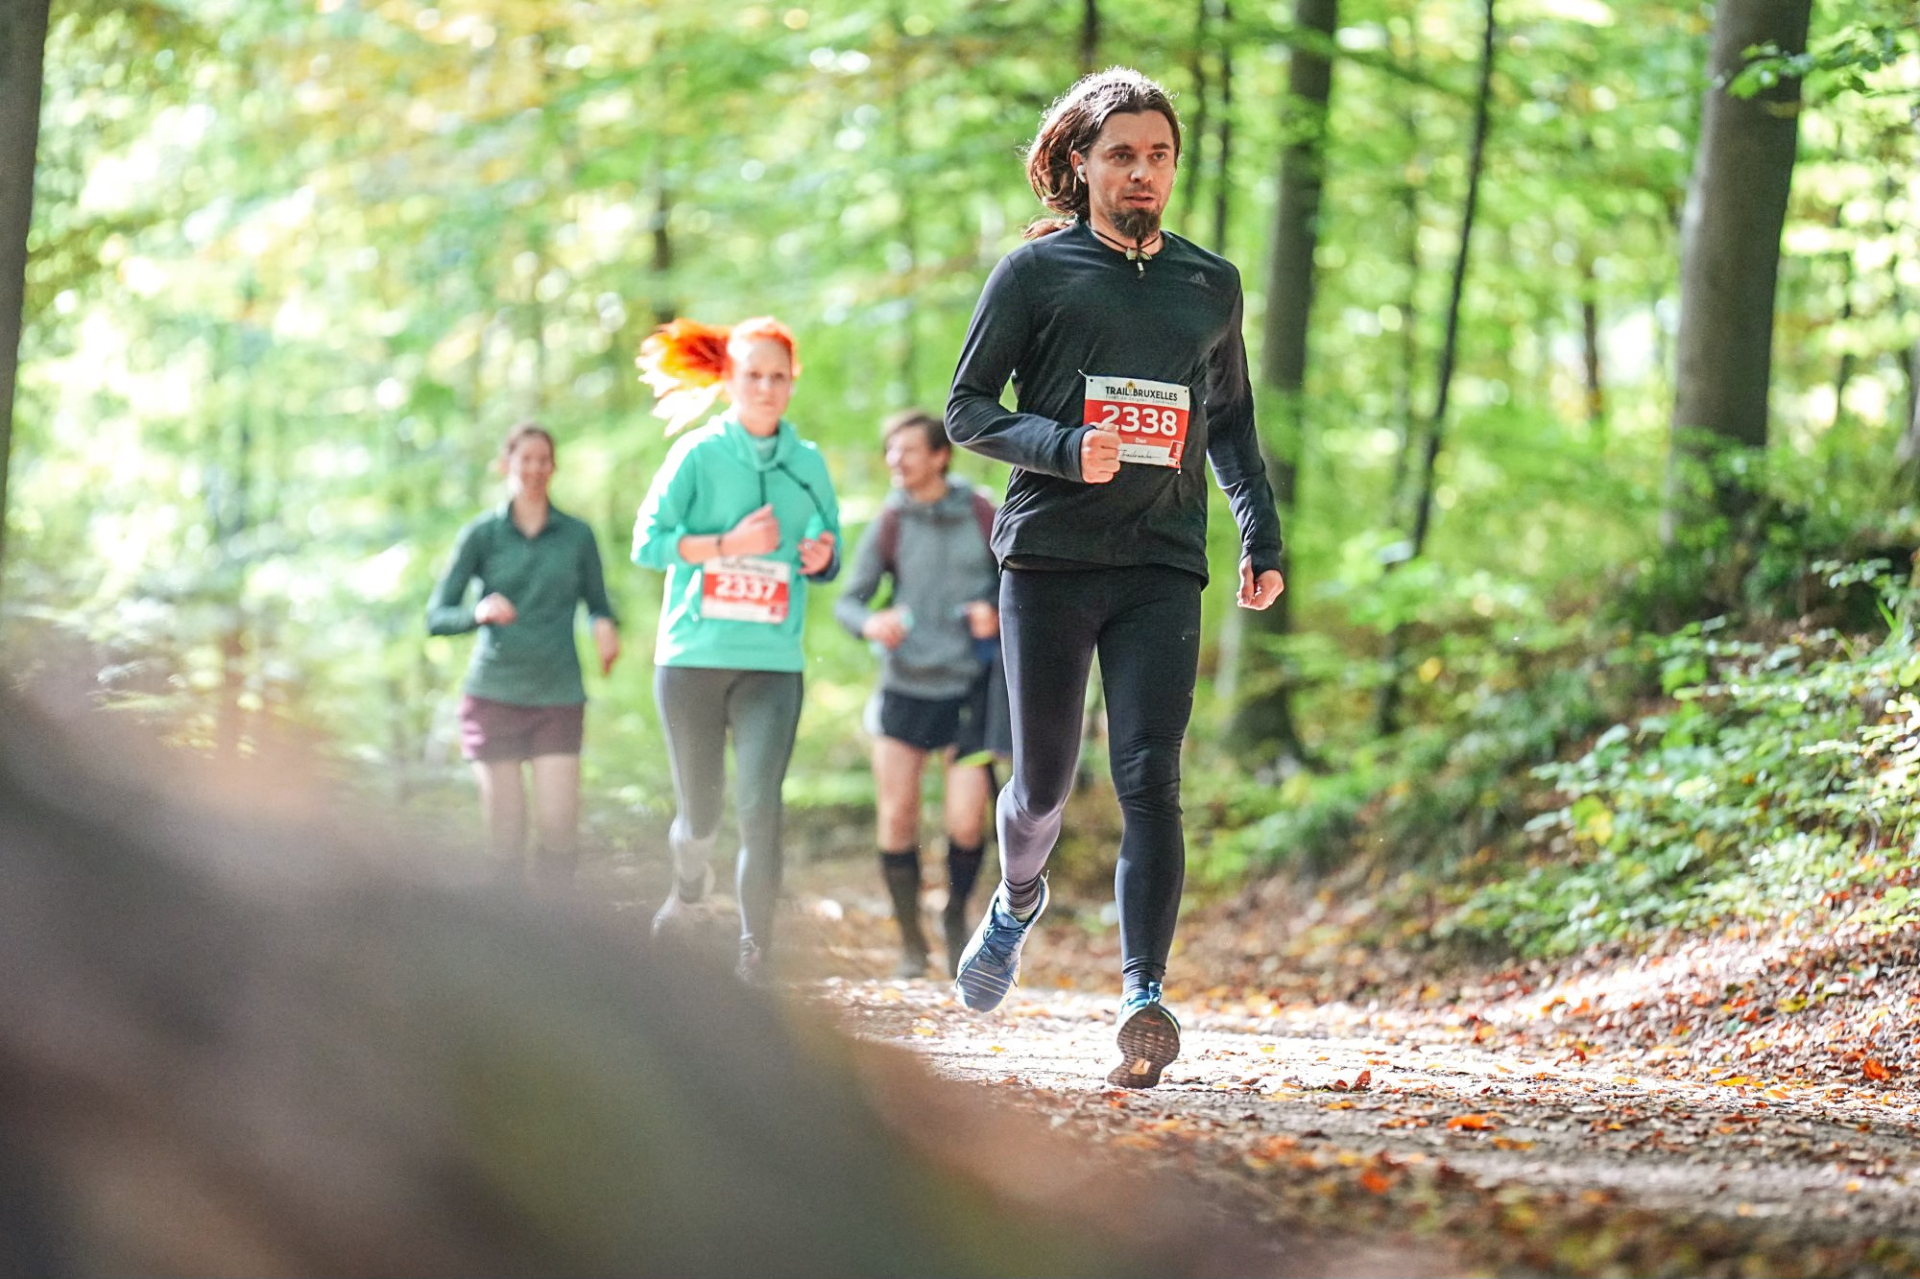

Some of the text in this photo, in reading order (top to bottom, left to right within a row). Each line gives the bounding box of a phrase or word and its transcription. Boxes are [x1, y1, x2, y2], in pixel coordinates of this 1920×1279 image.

[1106, 386, 1177, 401] TRAIL BRUXELLES
[1101, 405, 1177, 436] 2338
[715, 577, 778, 600] 2337
